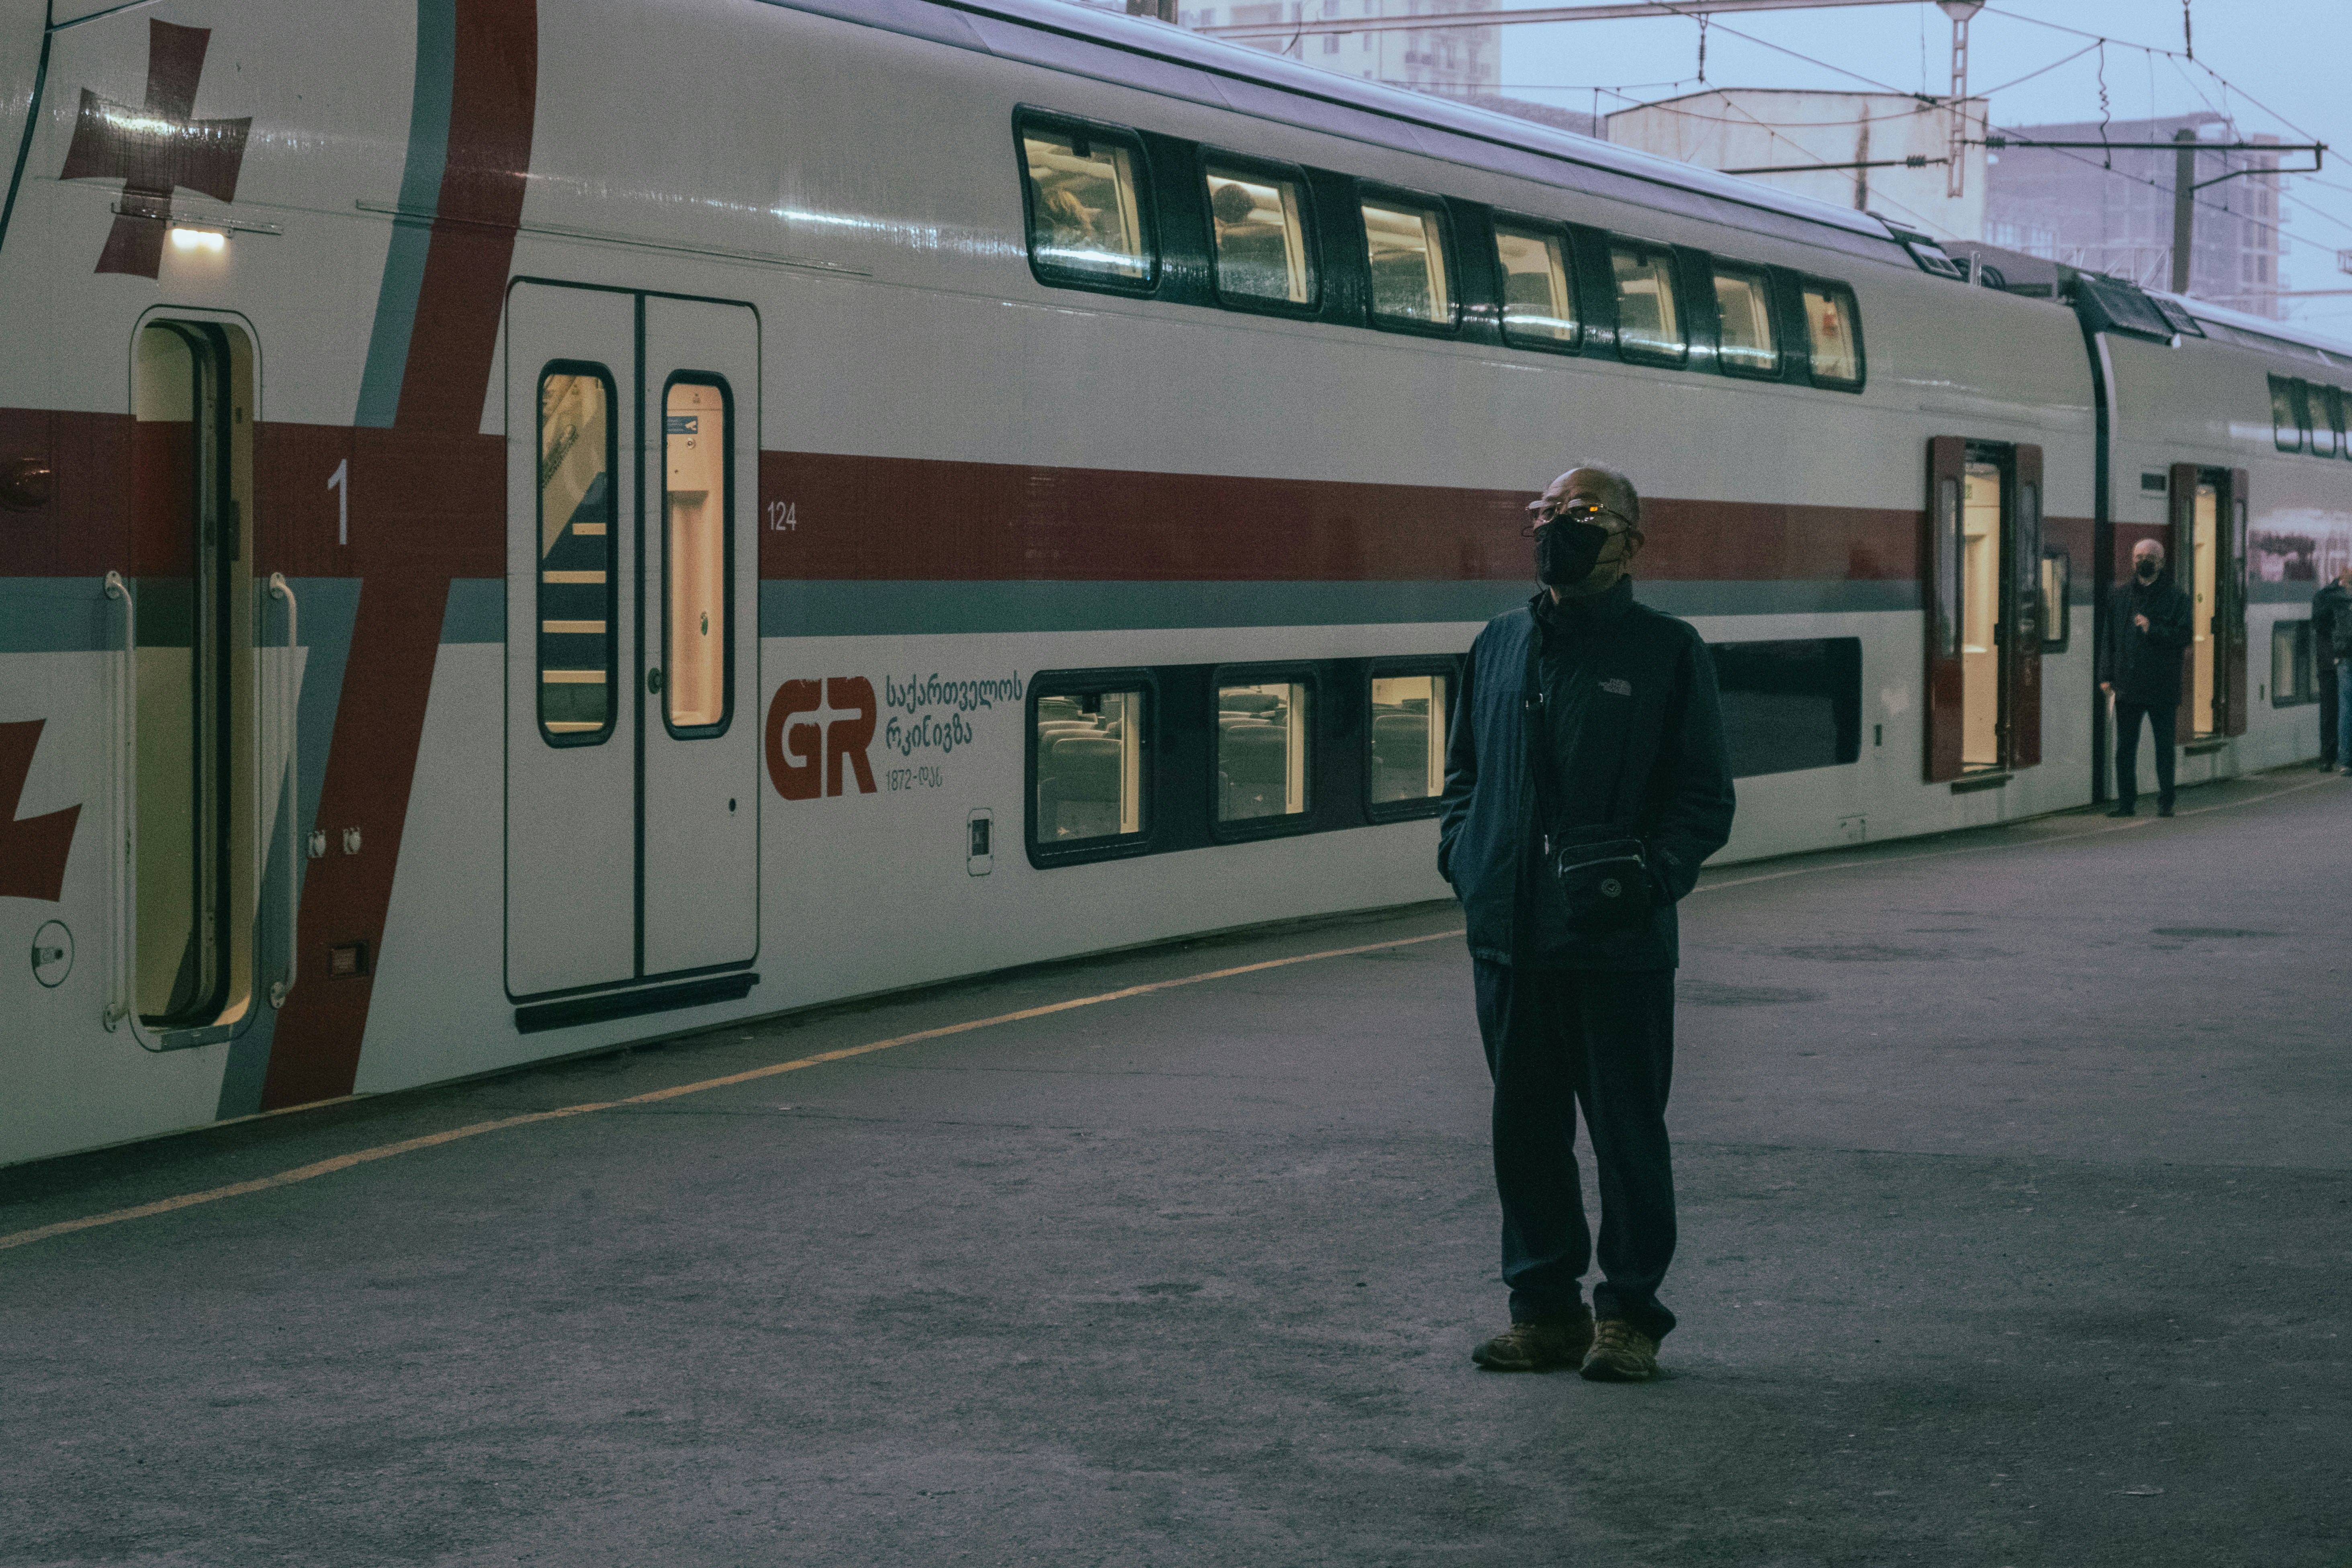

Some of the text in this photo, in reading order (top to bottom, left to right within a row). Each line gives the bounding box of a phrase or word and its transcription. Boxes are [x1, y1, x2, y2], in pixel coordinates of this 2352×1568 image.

[327, 458, 347, 545] 1
[768, 501, 796, 530] 124
[886, 670, 1022, 714] საქართველოს
[765, 676, 877, 801] GR
